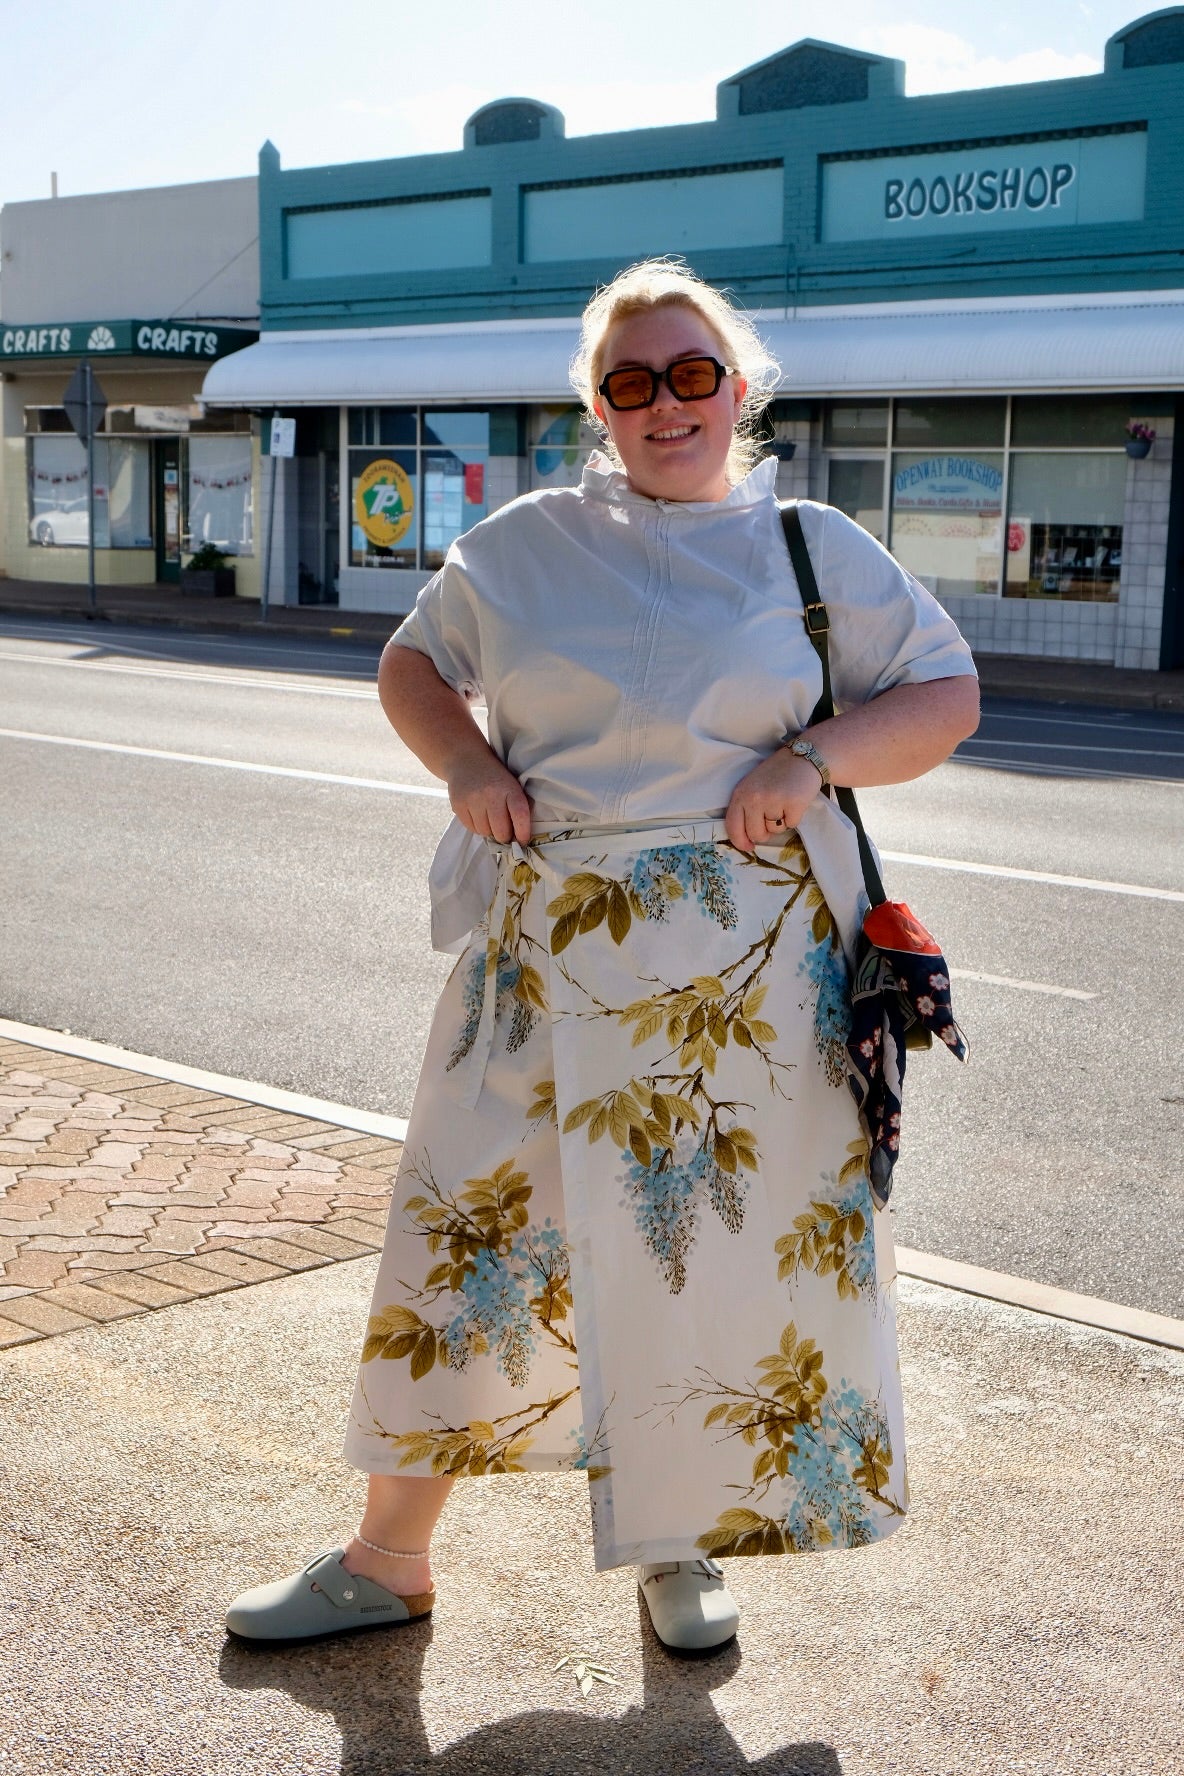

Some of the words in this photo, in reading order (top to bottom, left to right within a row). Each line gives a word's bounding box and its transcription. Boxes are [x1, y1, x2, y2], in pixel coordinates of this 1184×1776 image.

[885, 164, 1075, 221] BOOKSHOP
[3, 328, 71, 353] CRAFTS
[137, 326, 218, 355] CRAFTS
[896, 458, 944, 492] OPENWAY
[947, 457, 1003, 492] BOOKSHOP
[369, 484, 399, 514] TP
